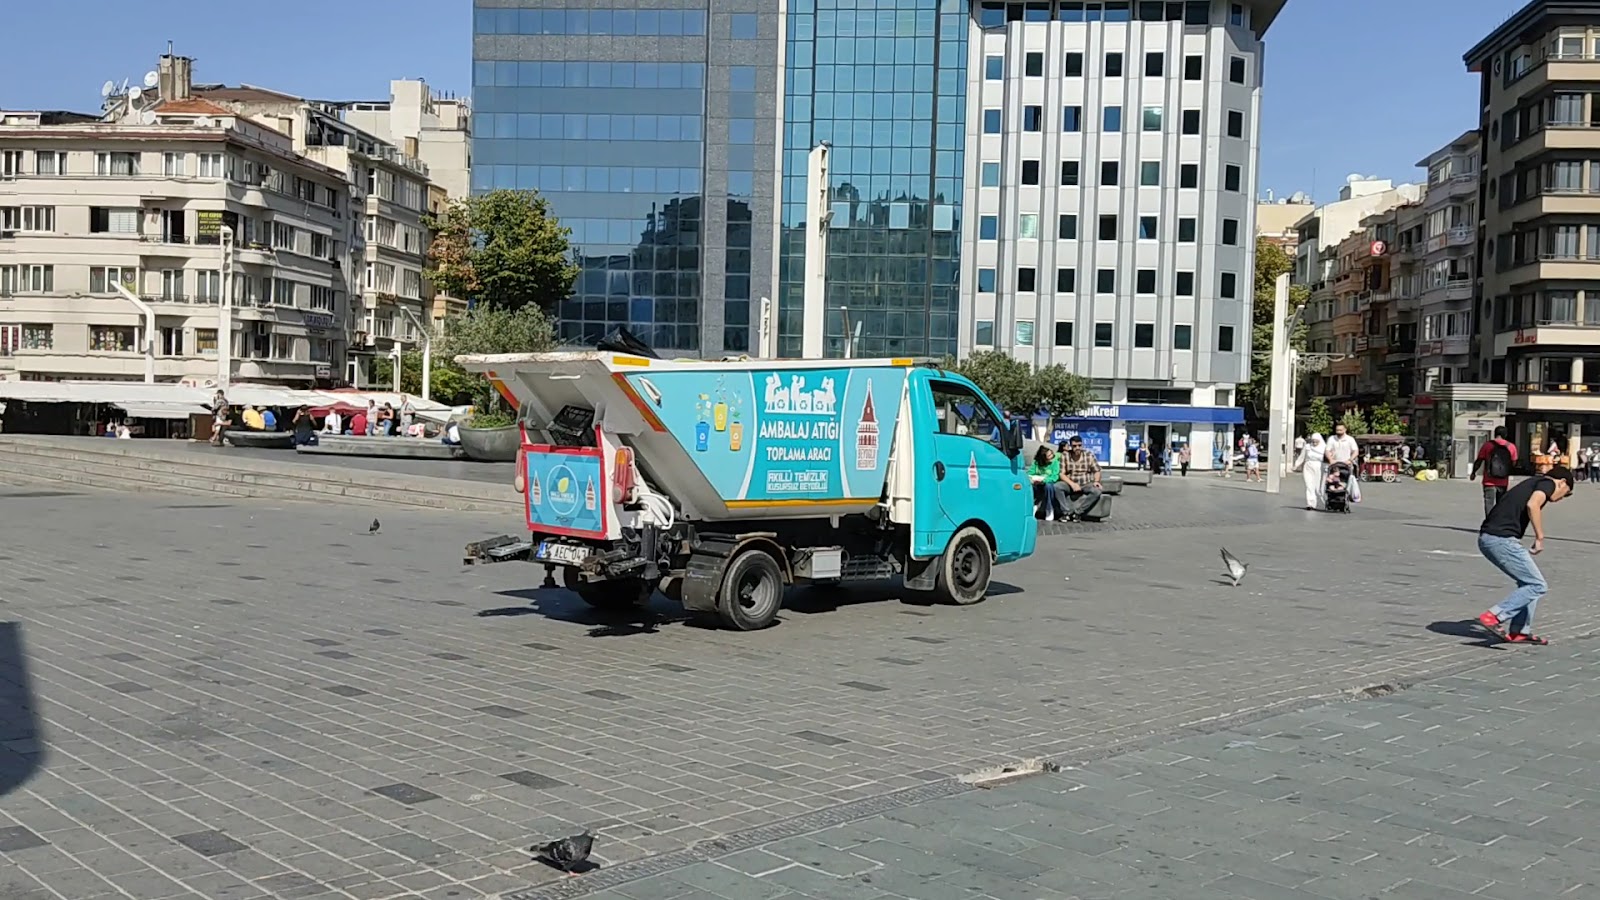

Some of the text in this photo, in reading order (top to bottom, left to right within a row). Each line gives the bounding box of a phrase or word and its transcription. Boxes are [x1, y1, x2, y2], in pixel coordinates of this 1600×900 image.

[759, 417, 839, 439] AMBALAJ ATIĞI
[1054, 422, 1079, 430] INSTANT
[1054, 430, 1079, 440] CASH
[766, 446, 831, 461] TOPLAMA ARACI
[554, 546, 568, 559] AEC
